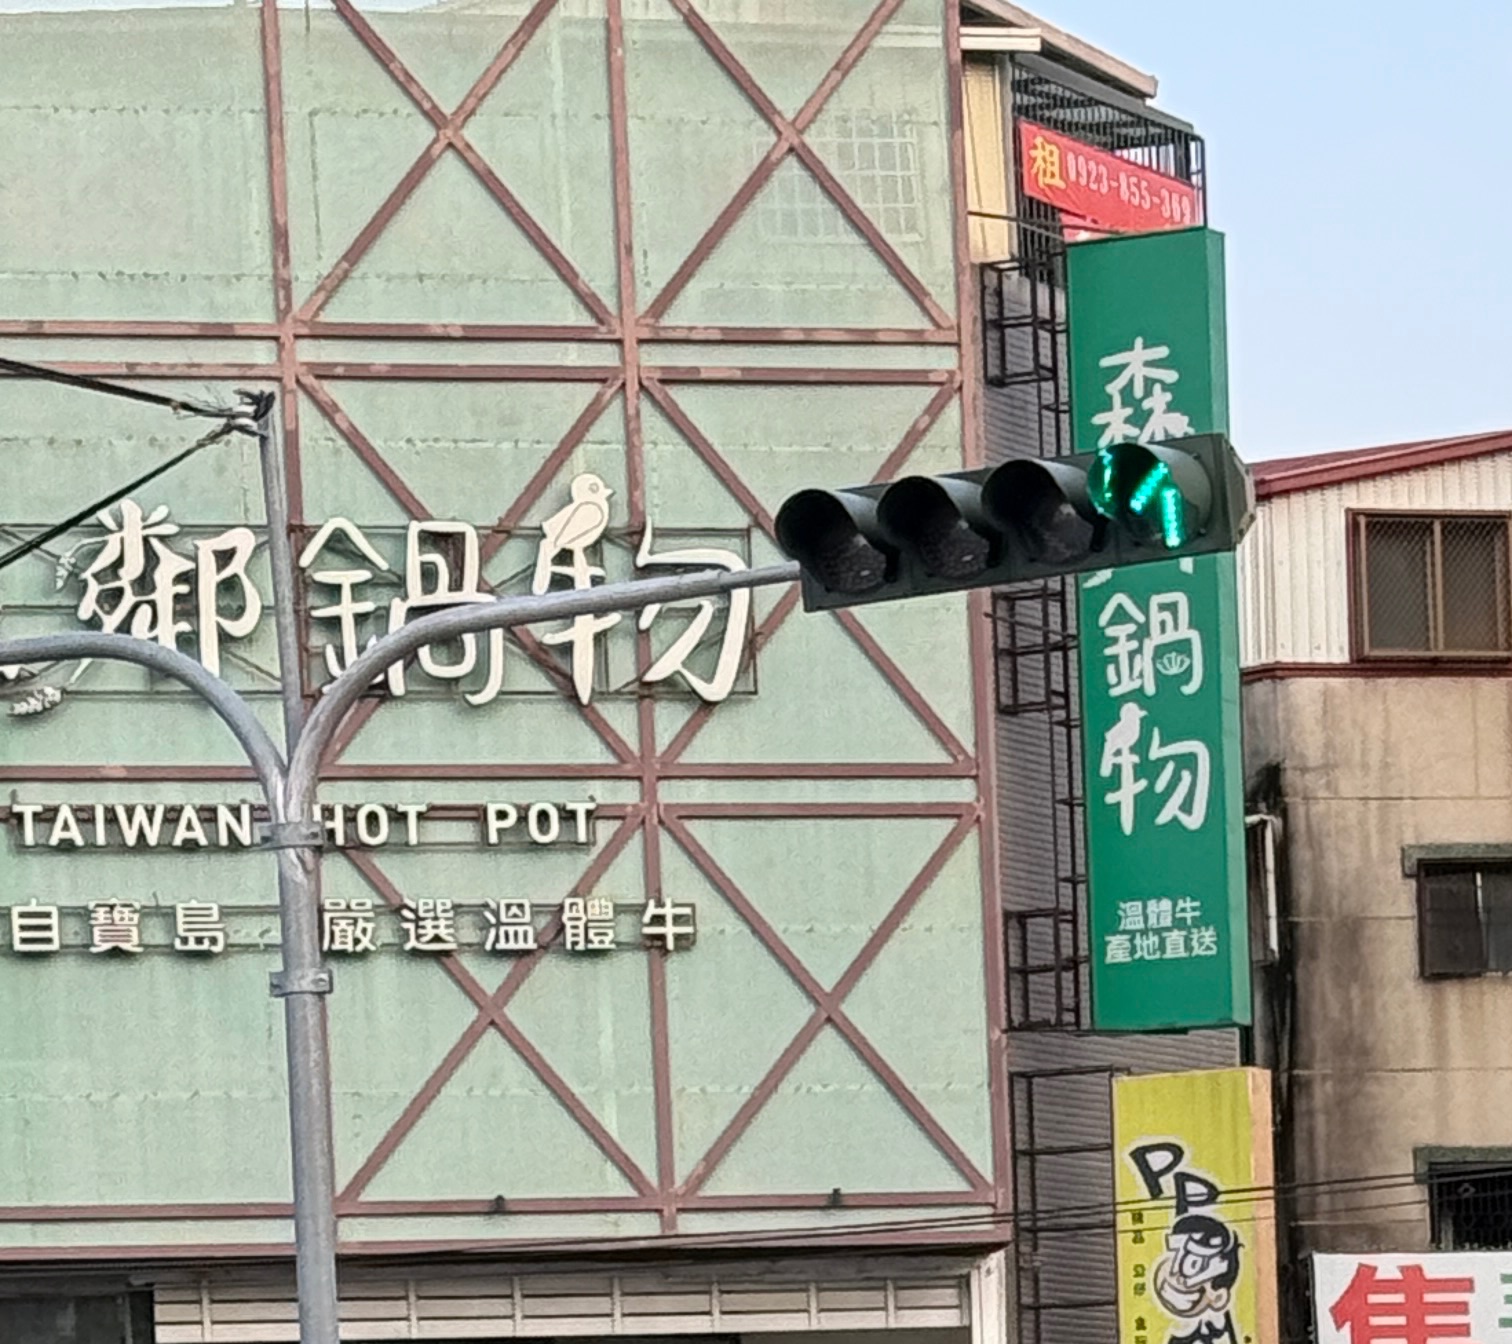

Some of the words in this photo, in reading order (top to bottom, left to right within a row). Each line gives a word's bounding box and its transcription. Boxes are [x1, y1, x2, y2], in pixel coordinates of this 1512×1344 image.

[1029, 136, 1066, 190] 租
[12, 803, 252, 847] TAIWAN
[314, 803, 427, 846] HOT
[486, 801, 597, 844] POT
[11, 898, 227, 954] 自寶島
[321, 898, 696, 954] 嚴選溫體牛
[1117, 898, 1202, 932] 溫體牛
[1103, 925, 1219, 965] 產地直送
